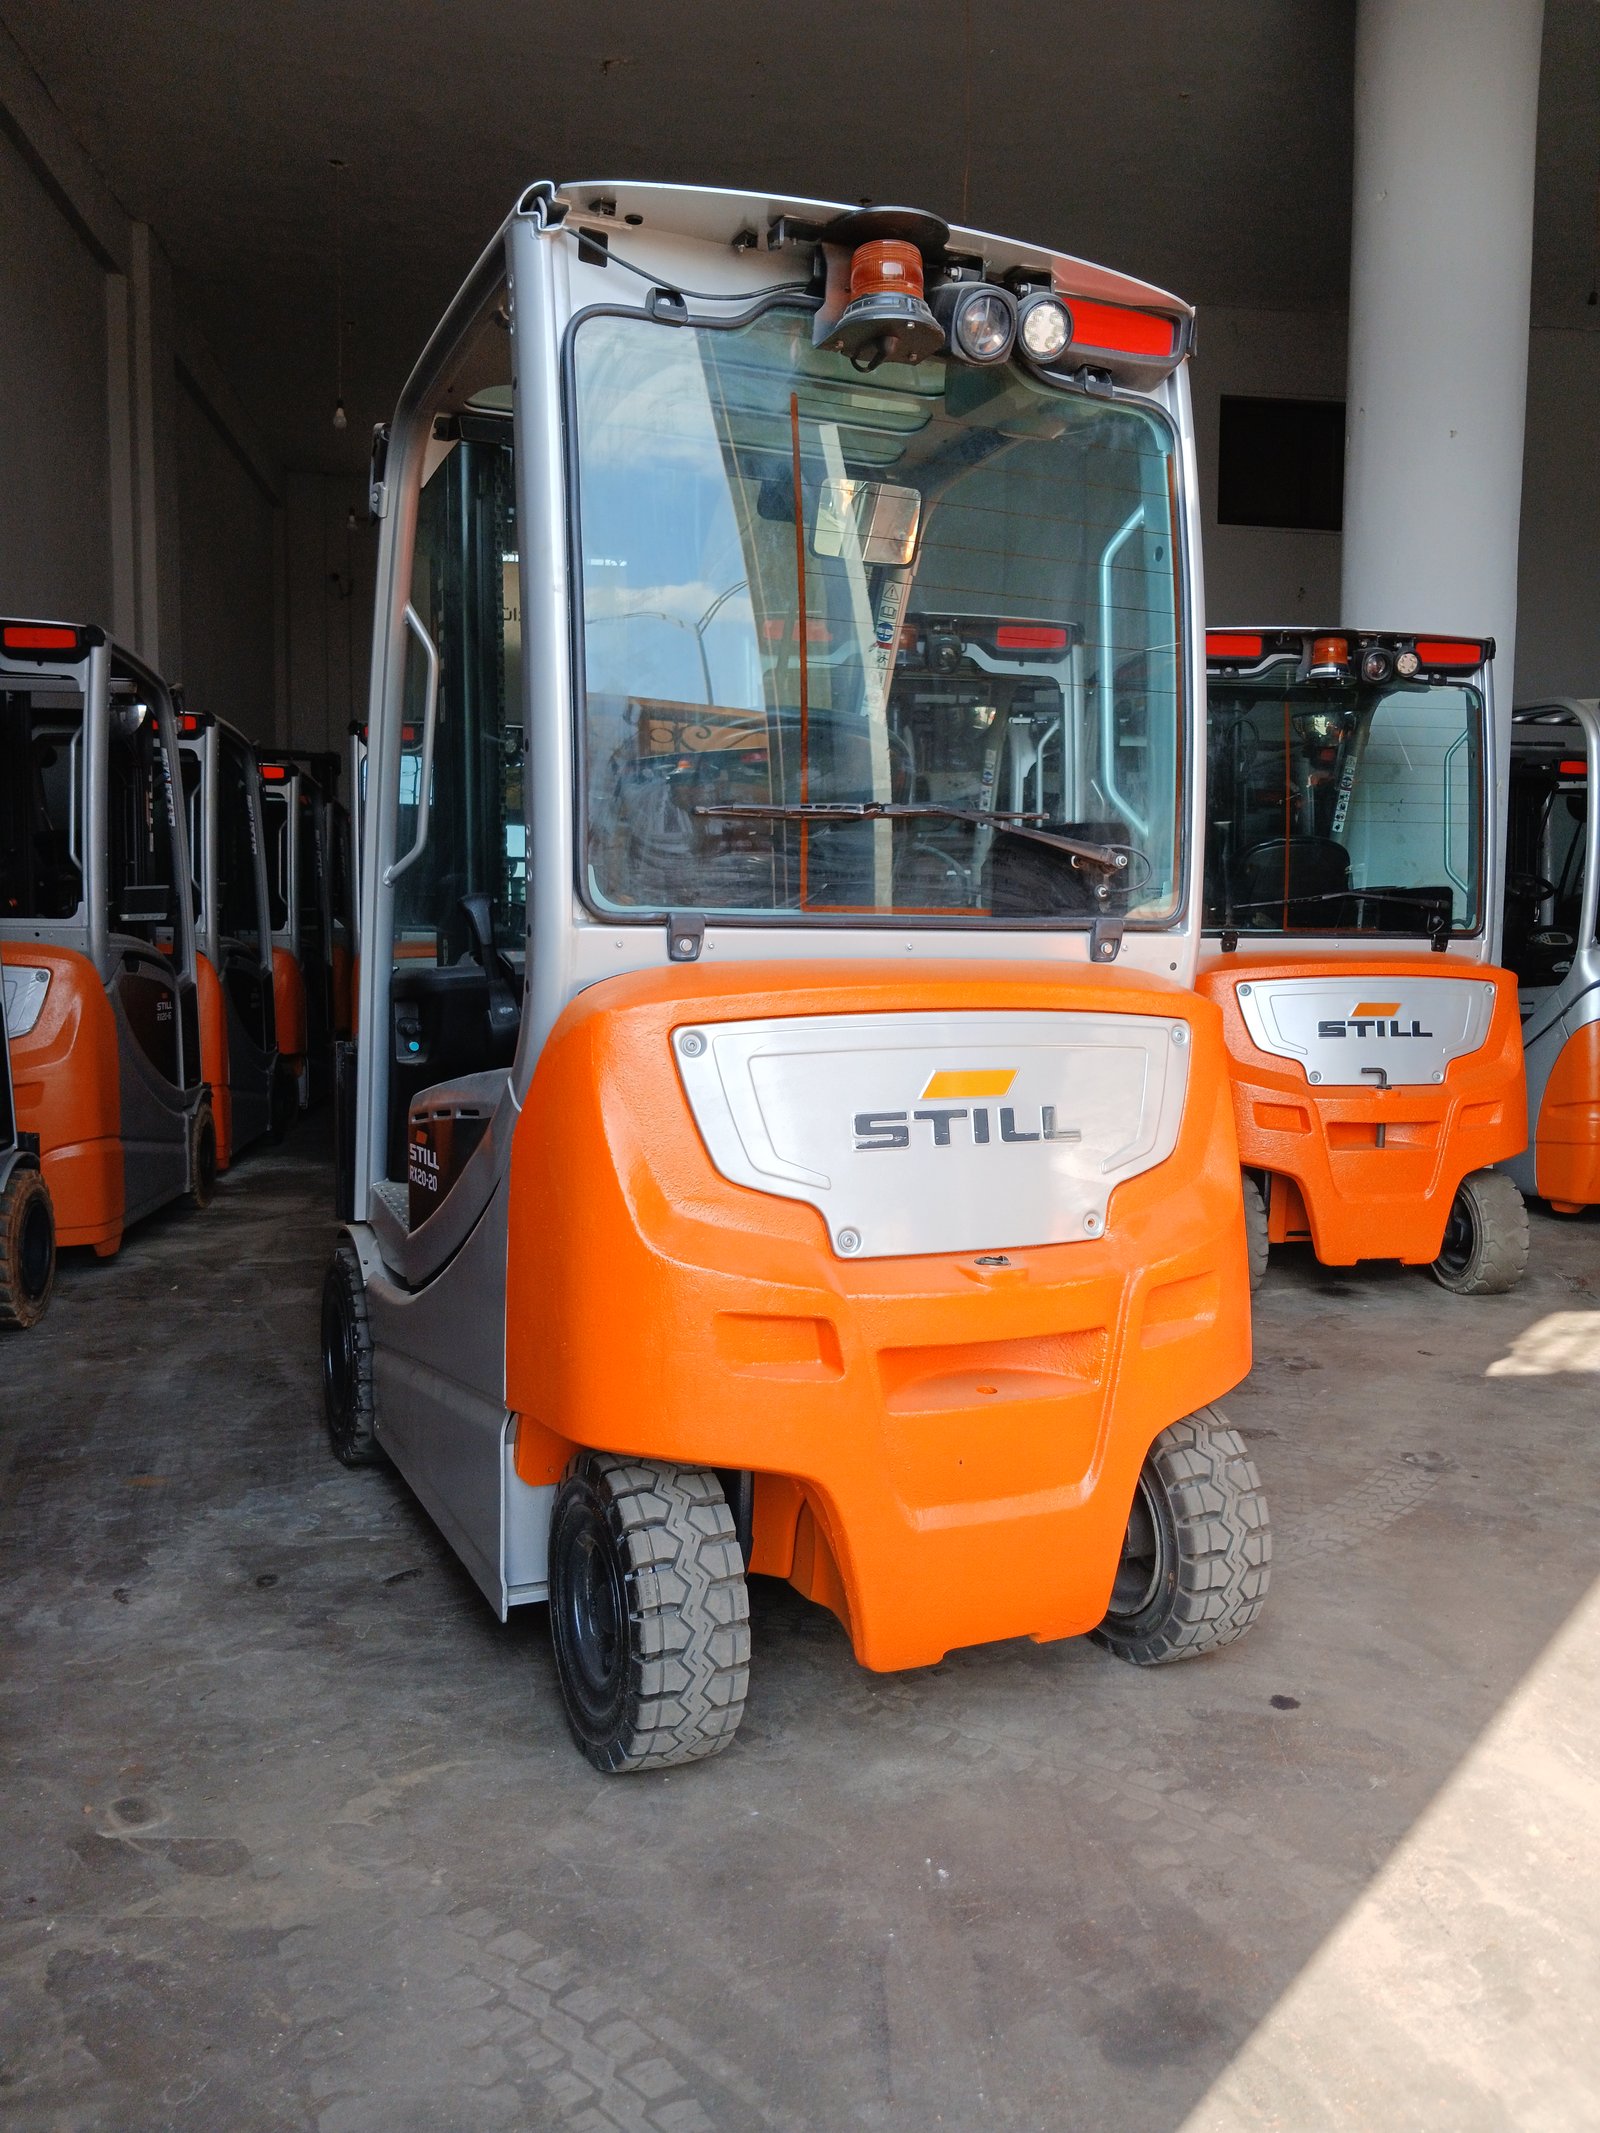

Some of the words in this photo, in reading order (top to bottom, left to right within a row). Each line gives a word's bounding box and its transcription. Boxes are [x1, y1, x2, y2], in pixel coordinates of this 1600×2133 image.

[1317, 1020, 1433, 1038] STILL
[853, 1105, 1082, 1151] STILL
[409, 1142, 440, 1170] STILL
[409, 1165, 438, 1192] RX20-20
